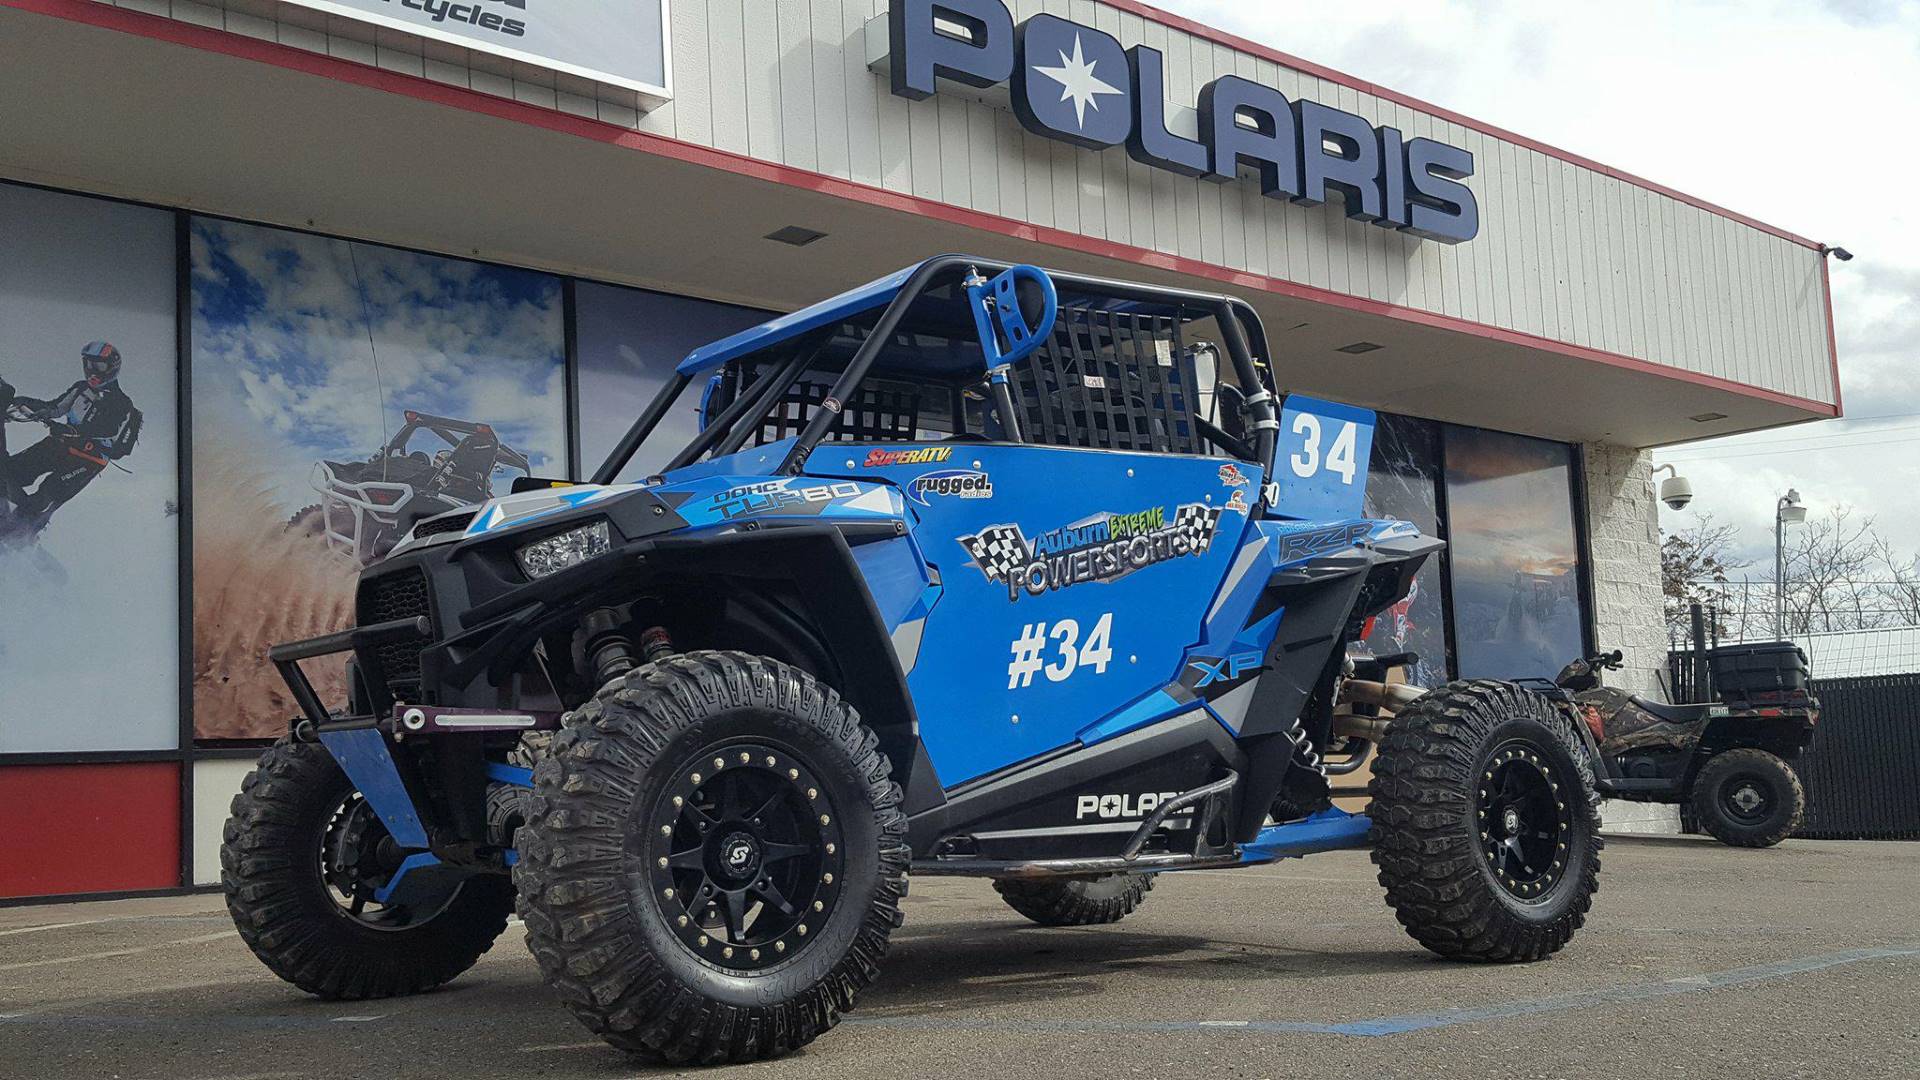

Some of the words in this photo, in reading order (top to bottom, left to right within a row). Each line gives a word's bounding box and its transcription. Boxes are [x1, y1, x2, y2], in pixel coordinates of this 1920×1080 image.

[380, 0, 526, 37] cycles
[891, 0, 1479, 244] POLARIS
[1291, 413, 1357, 485] 34
[708, 482, 862, 520] TURBO
[713, 482, 778, 503] DOHC
[1034, 520, 1109, 557] Auburn
[1108, 506, 1165, 541] EXTREME
[1008, 524, 1191, 602] POWERSPORTS
[1008, 613, 1112, 690] #34
[1189, 650, 1263, 688] XP
[1076, 792, 1195, 819] POLA
